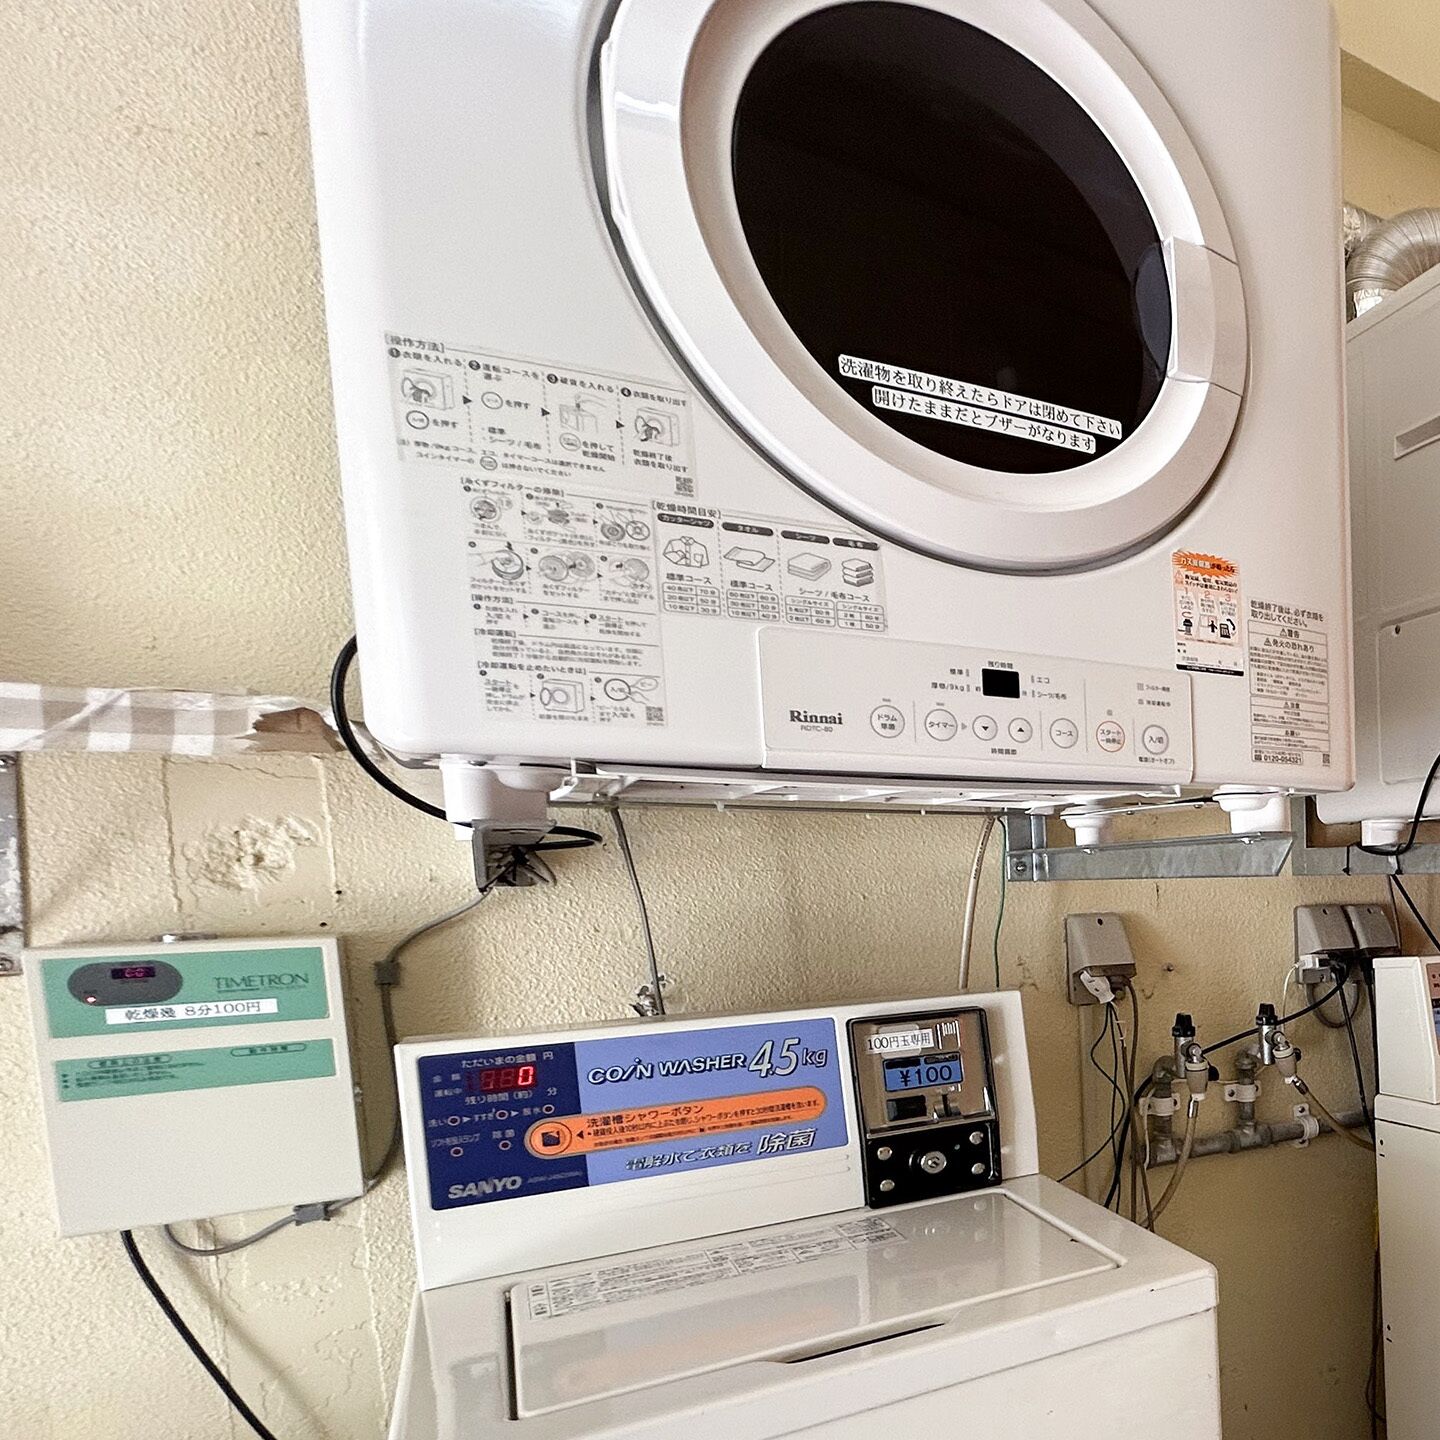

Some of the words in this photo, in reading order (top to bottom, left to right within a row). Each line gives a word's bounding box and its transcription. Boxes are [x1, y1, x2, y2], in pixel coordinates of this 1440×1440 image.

[840, 356, 1121, 437] 洗濯物を取り終えたらドアは閉めて下さい
[873, 388, 1095, 451] 開けたままだとブザーがなります
[789, 710, 843, 725] Rinnai
[928, 720, 955, 728] タイマー
[1055, 729, 1073, 737] コース
[214, 973, 310, 990] TIMETRON
[185, 1001, 261, 1017] 8分100円
[867, 1032, 931, 1050] 100円玉専用
[587, 1057, 653, 1085] COIN
[658, 1052, 746, 1077] WASHER
[900, 1065, 952, 1086] ¥100
[586, 1105, 704, 1128] 洗濯槽シャワーボタン
[757, 1128, 818, 1154] 除菌
[448, 1176, 522, 1199] SANYO
